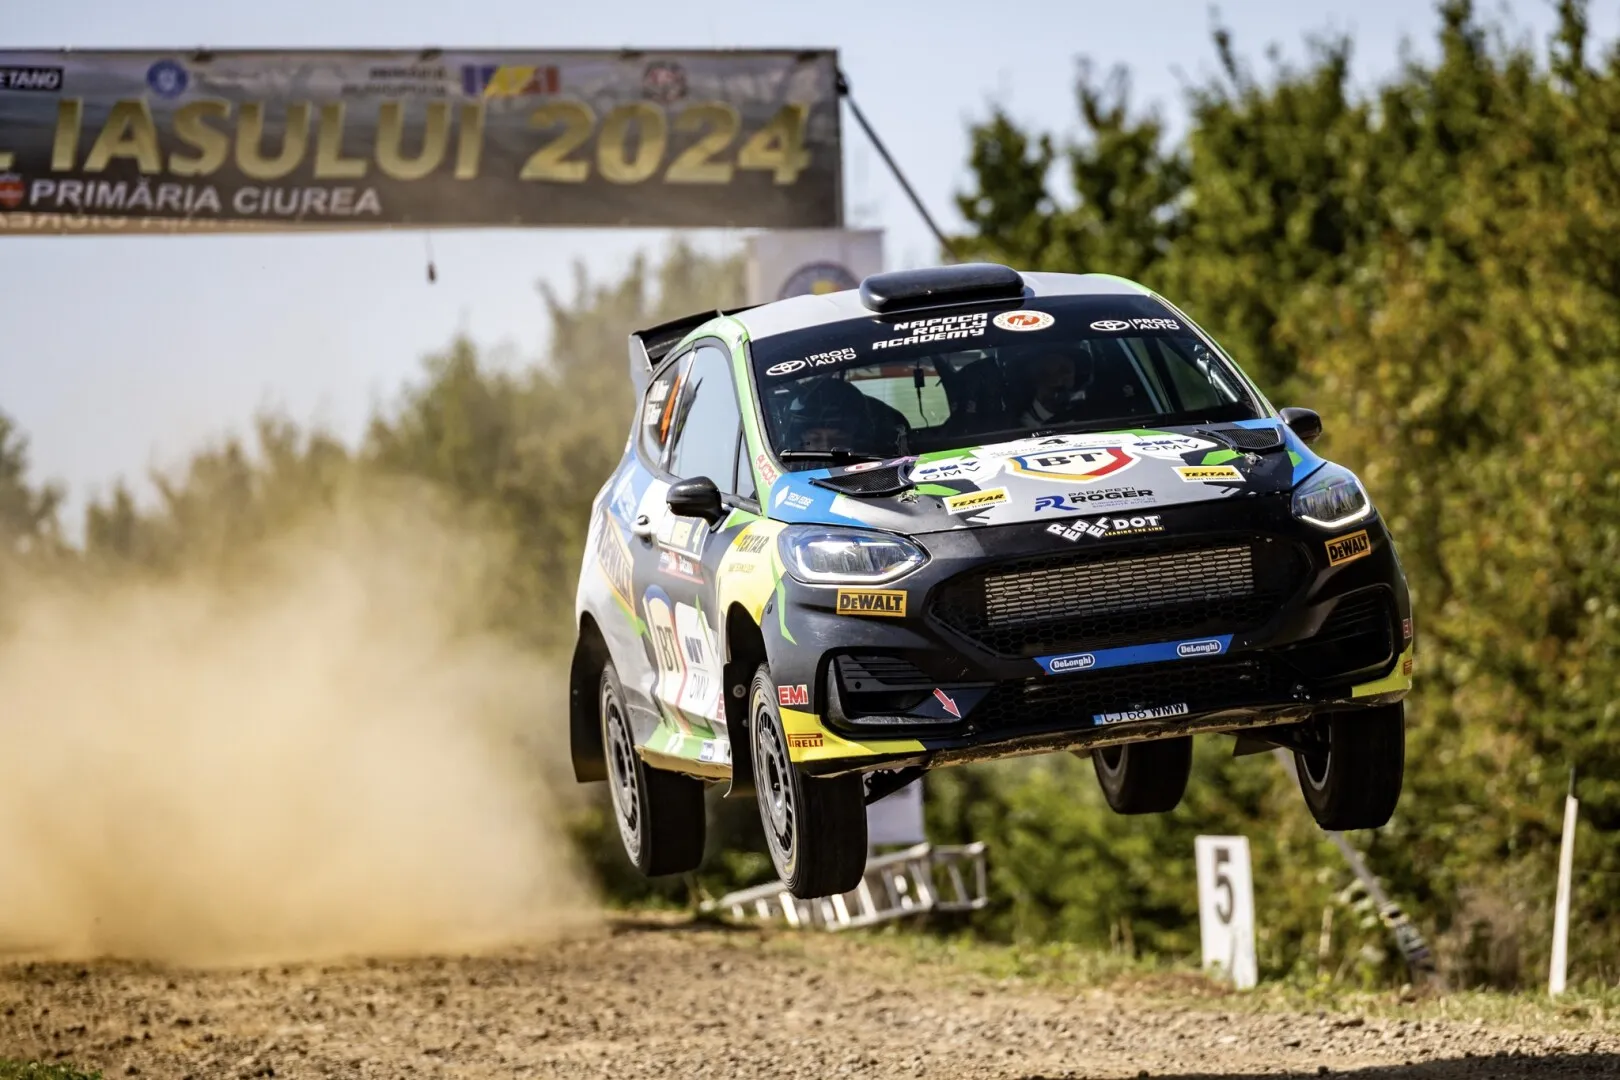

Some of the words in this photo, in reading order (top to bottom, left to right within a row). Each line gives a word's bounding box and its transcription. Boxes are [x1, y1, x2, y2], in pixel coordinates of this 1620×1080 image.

[520, 101, 810, 184] 2024
[232, 186, 382, 215] CIUREA
[893, 312, 988, 331] NAPOCA
[912, 321, 987, 336] RALLY
[872, 328, 985, 350] ACADEMY
[809, 347, 855, 361] PROFI
[815, 353, 857, 366] AUTO
[1142, 443, 1199, 452] OMV
[1034, 452, 1102, 467] BT
[923, 466, 981, 480] OMV
[952, 493, 1004, 508] TEXTAR
[1071, 489, 1153, 503] ROGER
[656, 625, 680, 673] BT
[1180, 640, 1219, 655] DeLonghi
[1053, 656, 1092, 670] DeLonghi
[1150, 704, 1185, 717] WMW
[787, 733, 823, 748] PIRELLI
[1214, 848, 1234, 925] 5
